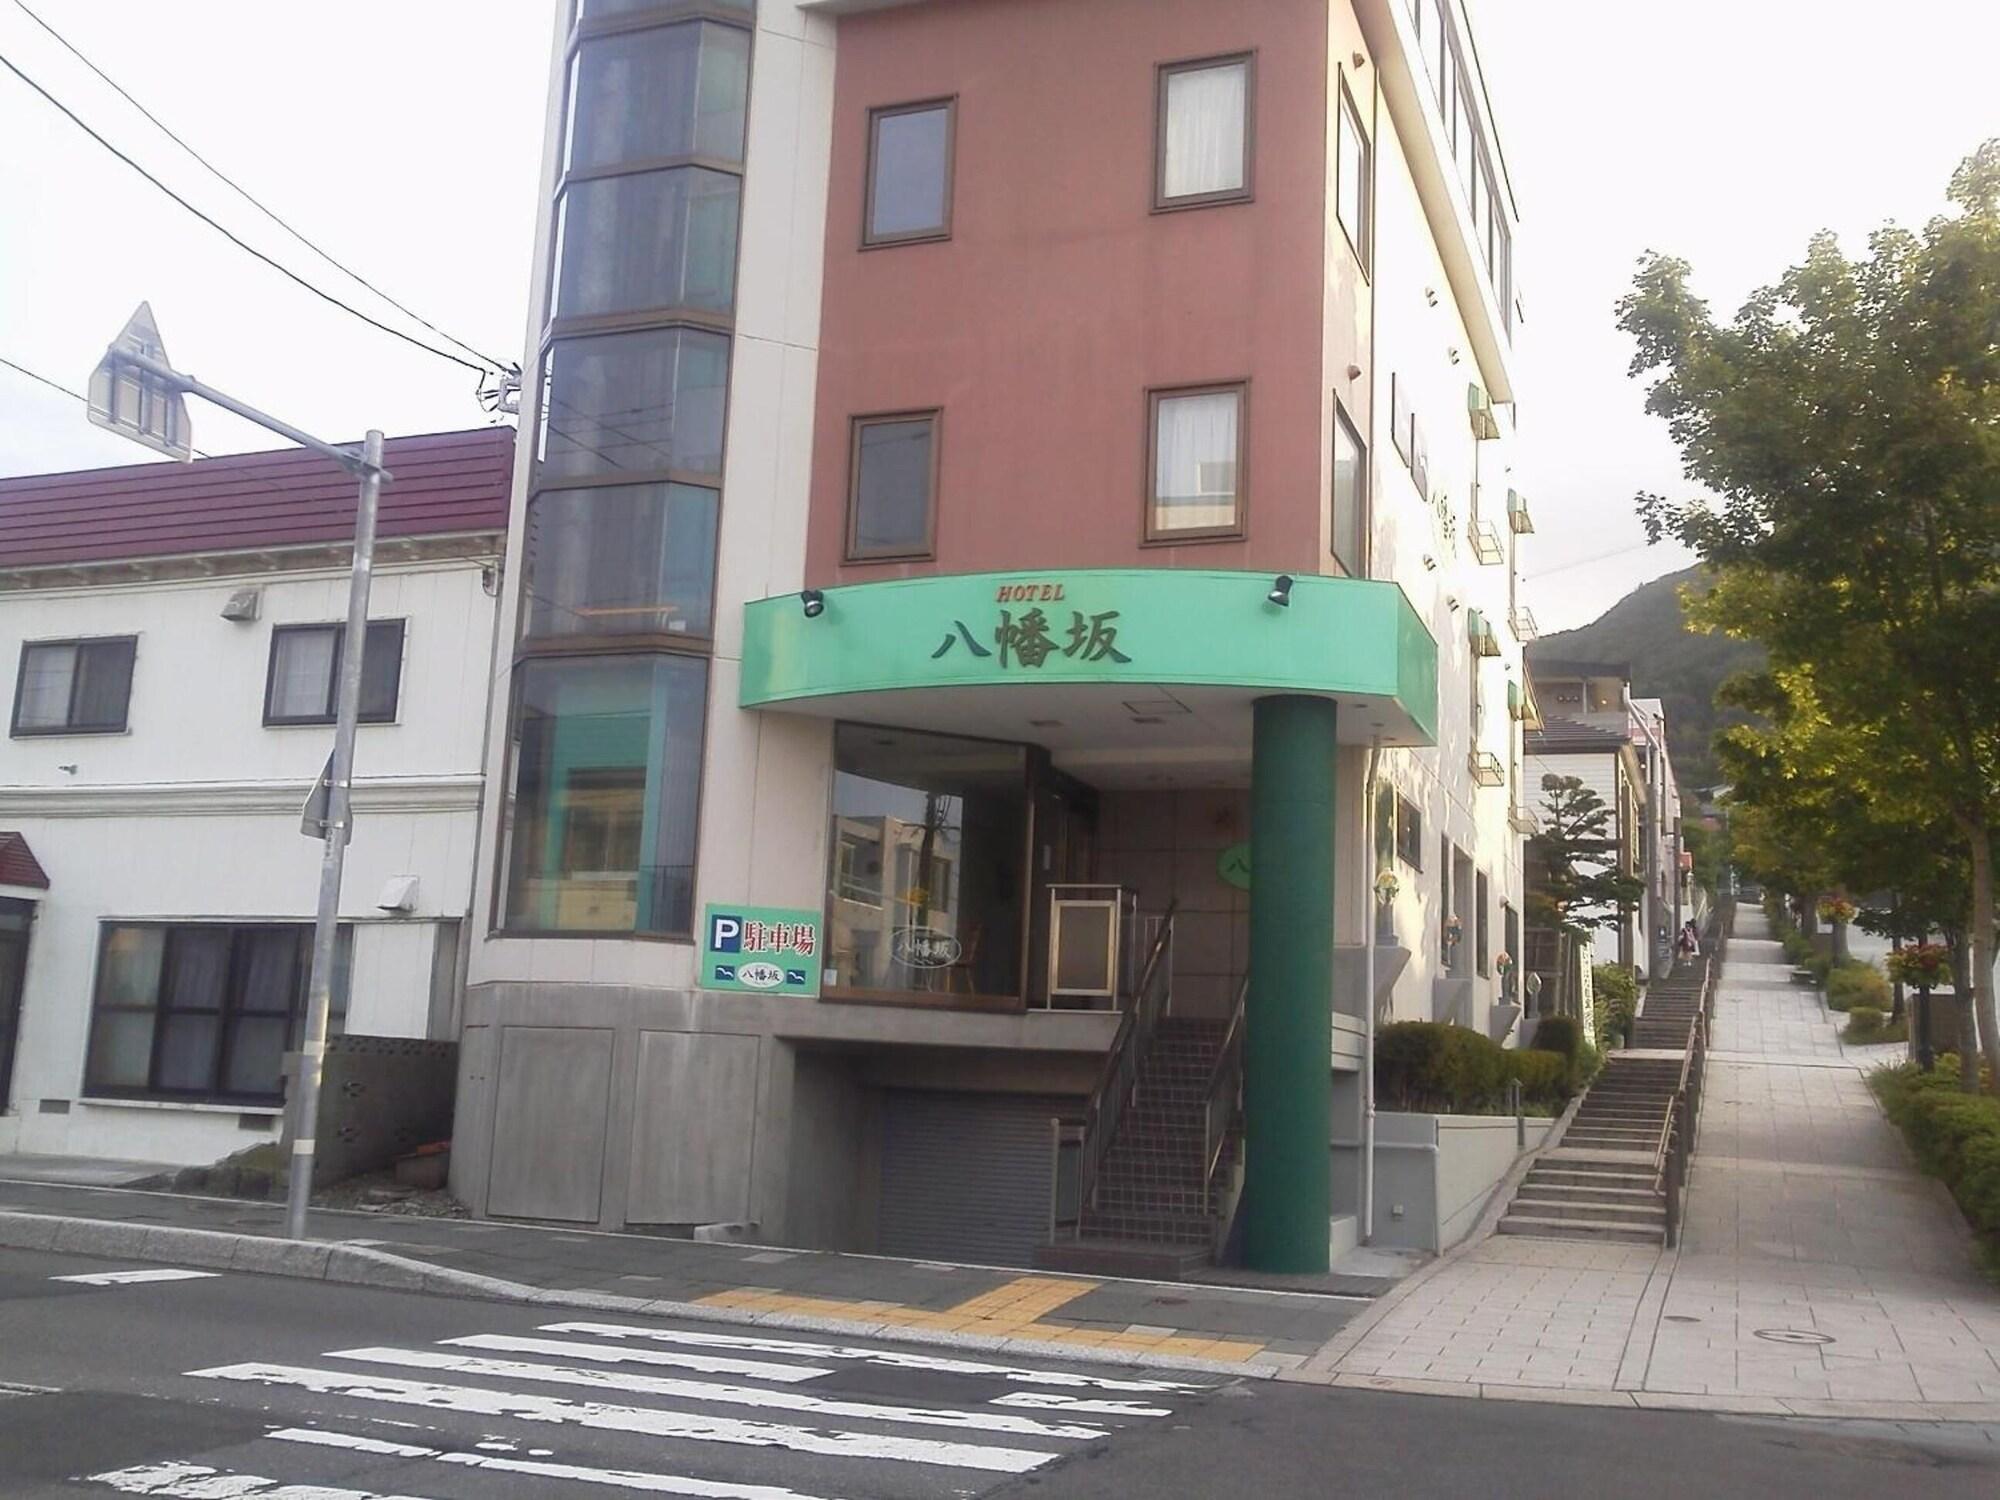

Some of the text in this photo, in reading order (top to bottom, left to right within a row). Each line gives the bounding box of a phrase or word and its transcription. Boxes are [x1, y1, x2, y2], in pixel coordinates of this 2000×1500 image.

[996, 584, 1065, 602] HOTEL
[931, 608, 1132, 668] 八幡坂
[715, 919, 815, 955] P 駐車場
